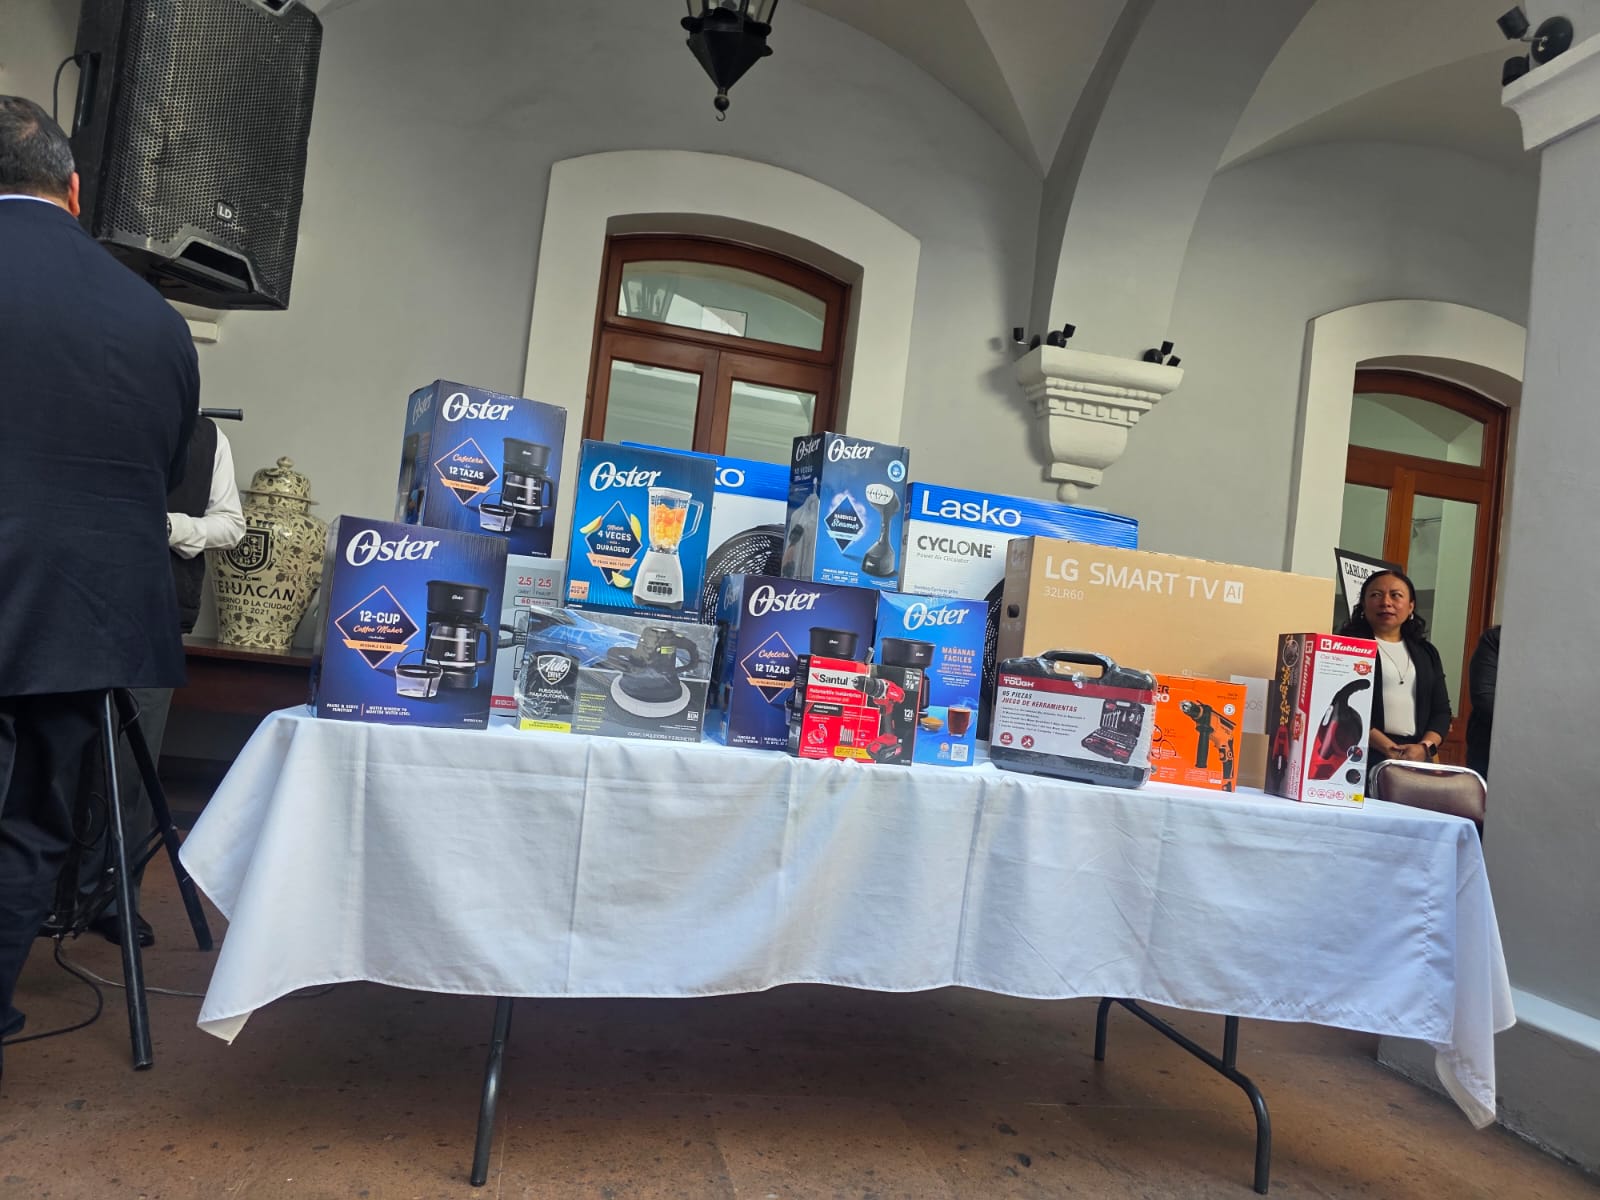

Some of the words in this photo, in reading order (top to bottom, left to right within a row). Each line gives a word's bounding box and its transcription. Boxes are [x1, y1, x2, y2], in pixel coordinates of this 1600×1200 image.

[220, 206, 232, 219] LD
[442, 392, 514, 422] Oster
[796, 438, 821, 462] Oster
[827, 438, 874, 463] Oster
[453, 453, 484, 464] Cafetera
[449, 466, 458, 475] 12
[459, 468, 485, 479] TAZAS
[589, 461, 662, 491] Oster
[921, 490, 1021, 527] Lasko
[606, 531, 632, 541] VECES
[346, 529, 439, 566] Oster
[596, 544, 630, 554] DURADERO
[917, 535, 993, 559] CYCLONE
[1344, 562, 1369, 579] CARLOS
[518, 576, 532, 586] 2.5
[538, 578, 552, 588] 2.5
[1045, 555, 1079, 582] LG
[1088, 562, 1181, 596] SMART
[1186, 575, 1219, 600] TV
[1225, 583, 1243, 601] AI
[1043, 585, 1084, 600] 32LR60
[263, 601, 291, 611] CIUDAD
[748, 585, 821, 617] Oster
[250, 607, 270, 615] 2021
[360, 610, 400, 625] 12-CUP
[903, 602, 970, 631] Oster
[353, 625, 375, 633] Coffee
[377, 625, 403, 634] Maker
[758, 649, 790, 658] Cafetera
[942, 646, 976, 657] MAÑANAS
[1332, 641, 1373, 655] Koblenz
[538, 657, 568, 672] Auto
[755, 664, 764, 672] 12
[765, 664, 790, 674] TAZAS
[819, 674, 849, 686] Santul
[1003, 678, 1035, 688] TOUGH
[1011, 691, 1032, 699] PIEZAS
[1031, 701, 1078, 712] HERRAMIENTAS
